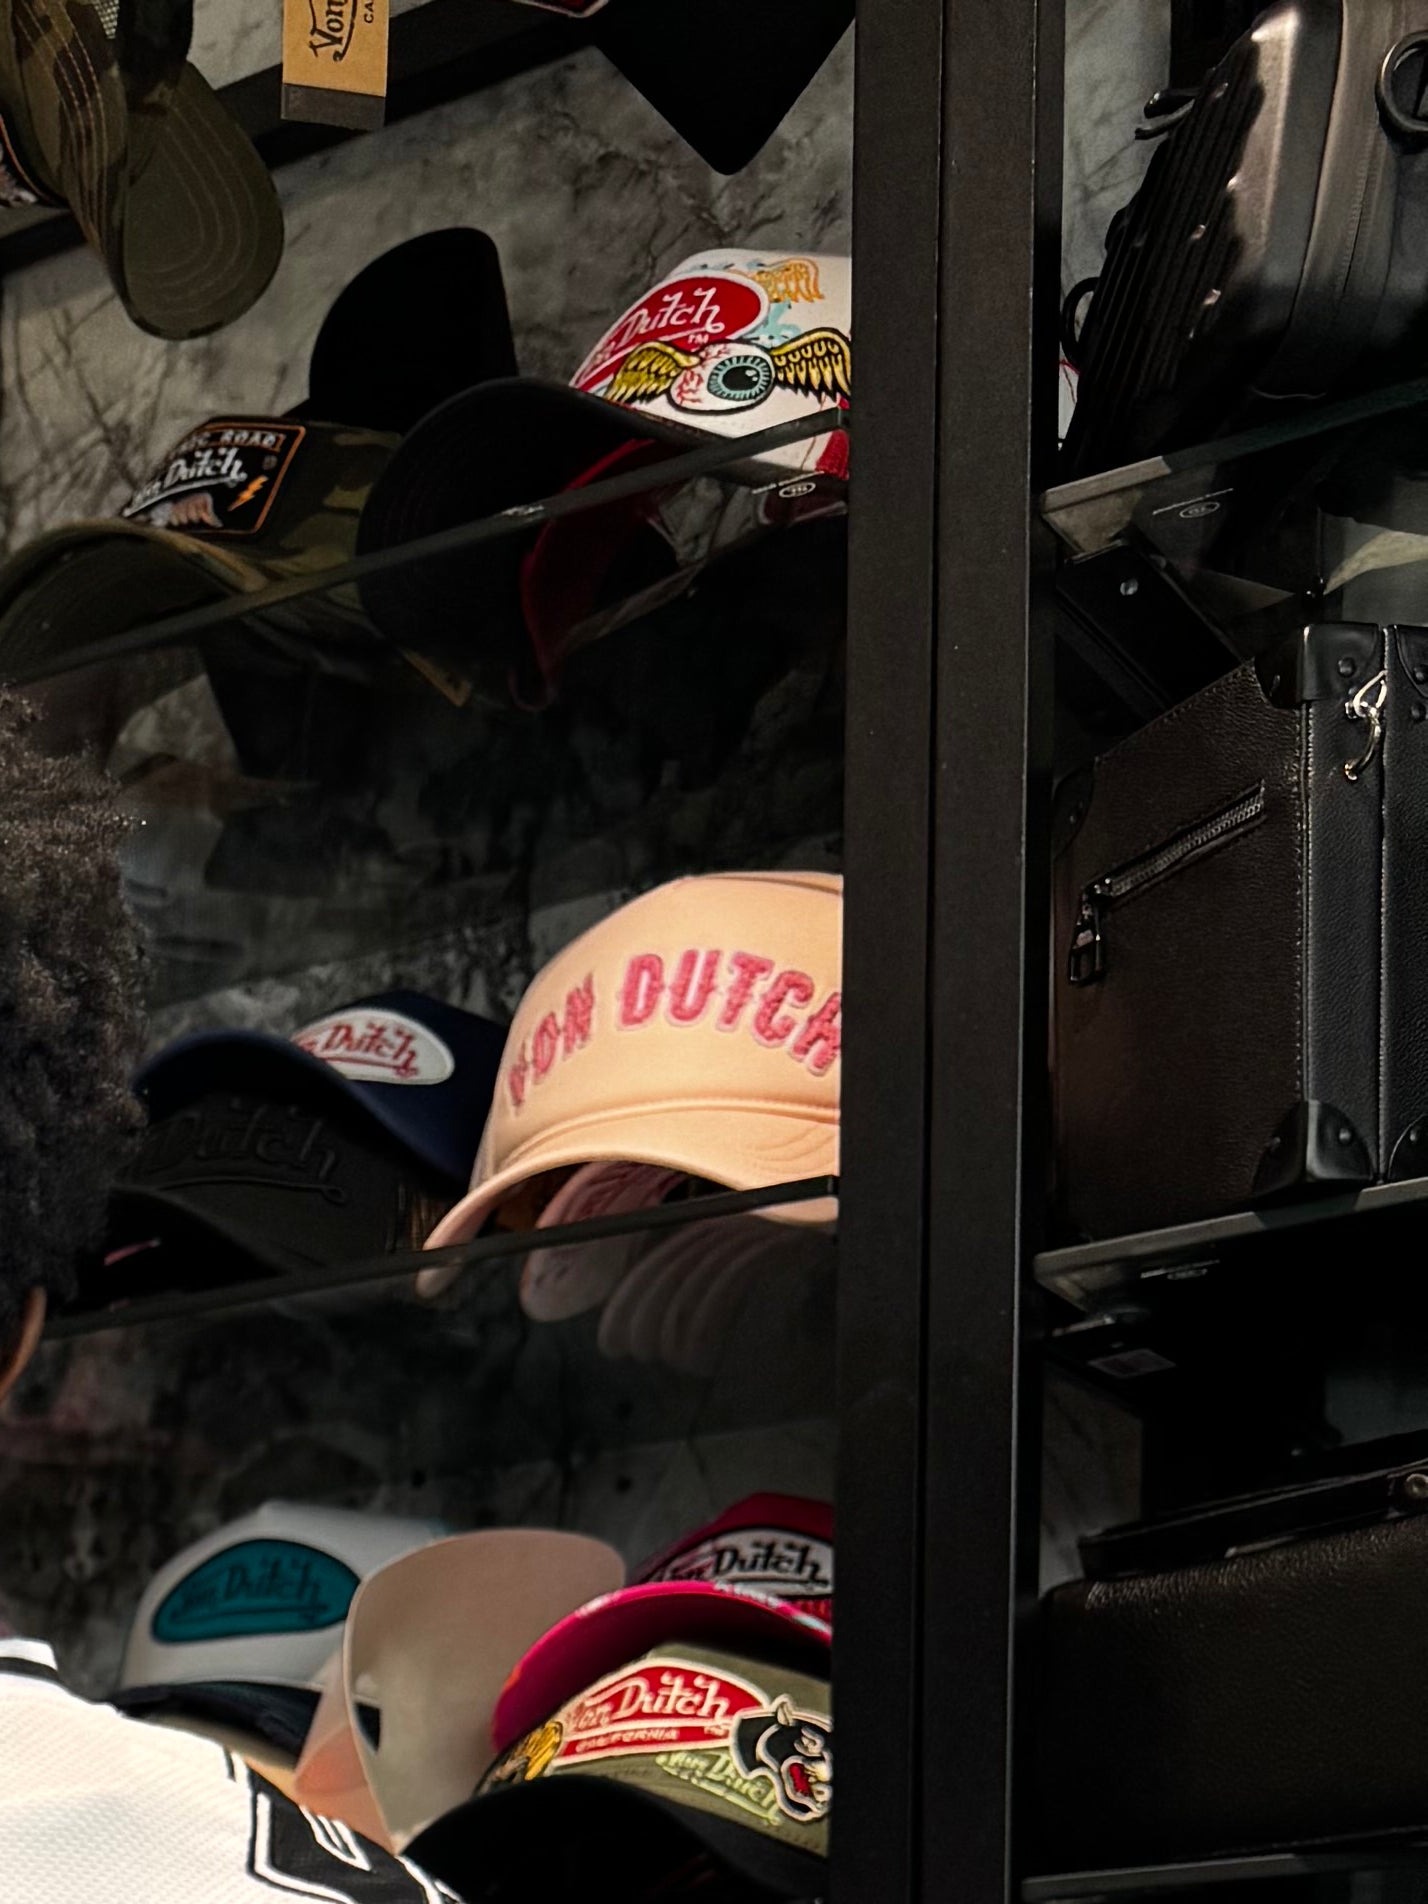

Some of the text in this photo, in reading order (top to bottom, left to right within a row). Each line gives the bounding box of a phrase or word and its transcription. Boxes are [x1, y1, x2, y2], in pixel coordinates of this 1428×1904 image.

[364, 0, 375, 24] CA
[618, 287, 725, 343] Dutch
[221, 429, 277, 448] ROAD
[163, 446, 248, 489] Dutch
[321, 1021, 419, 1074] Dutch
[507, 972, 595, 1110] VON
[712, 1540, 829, 1588] Dutch
[611, 1670, 734, 1724] Dutch
